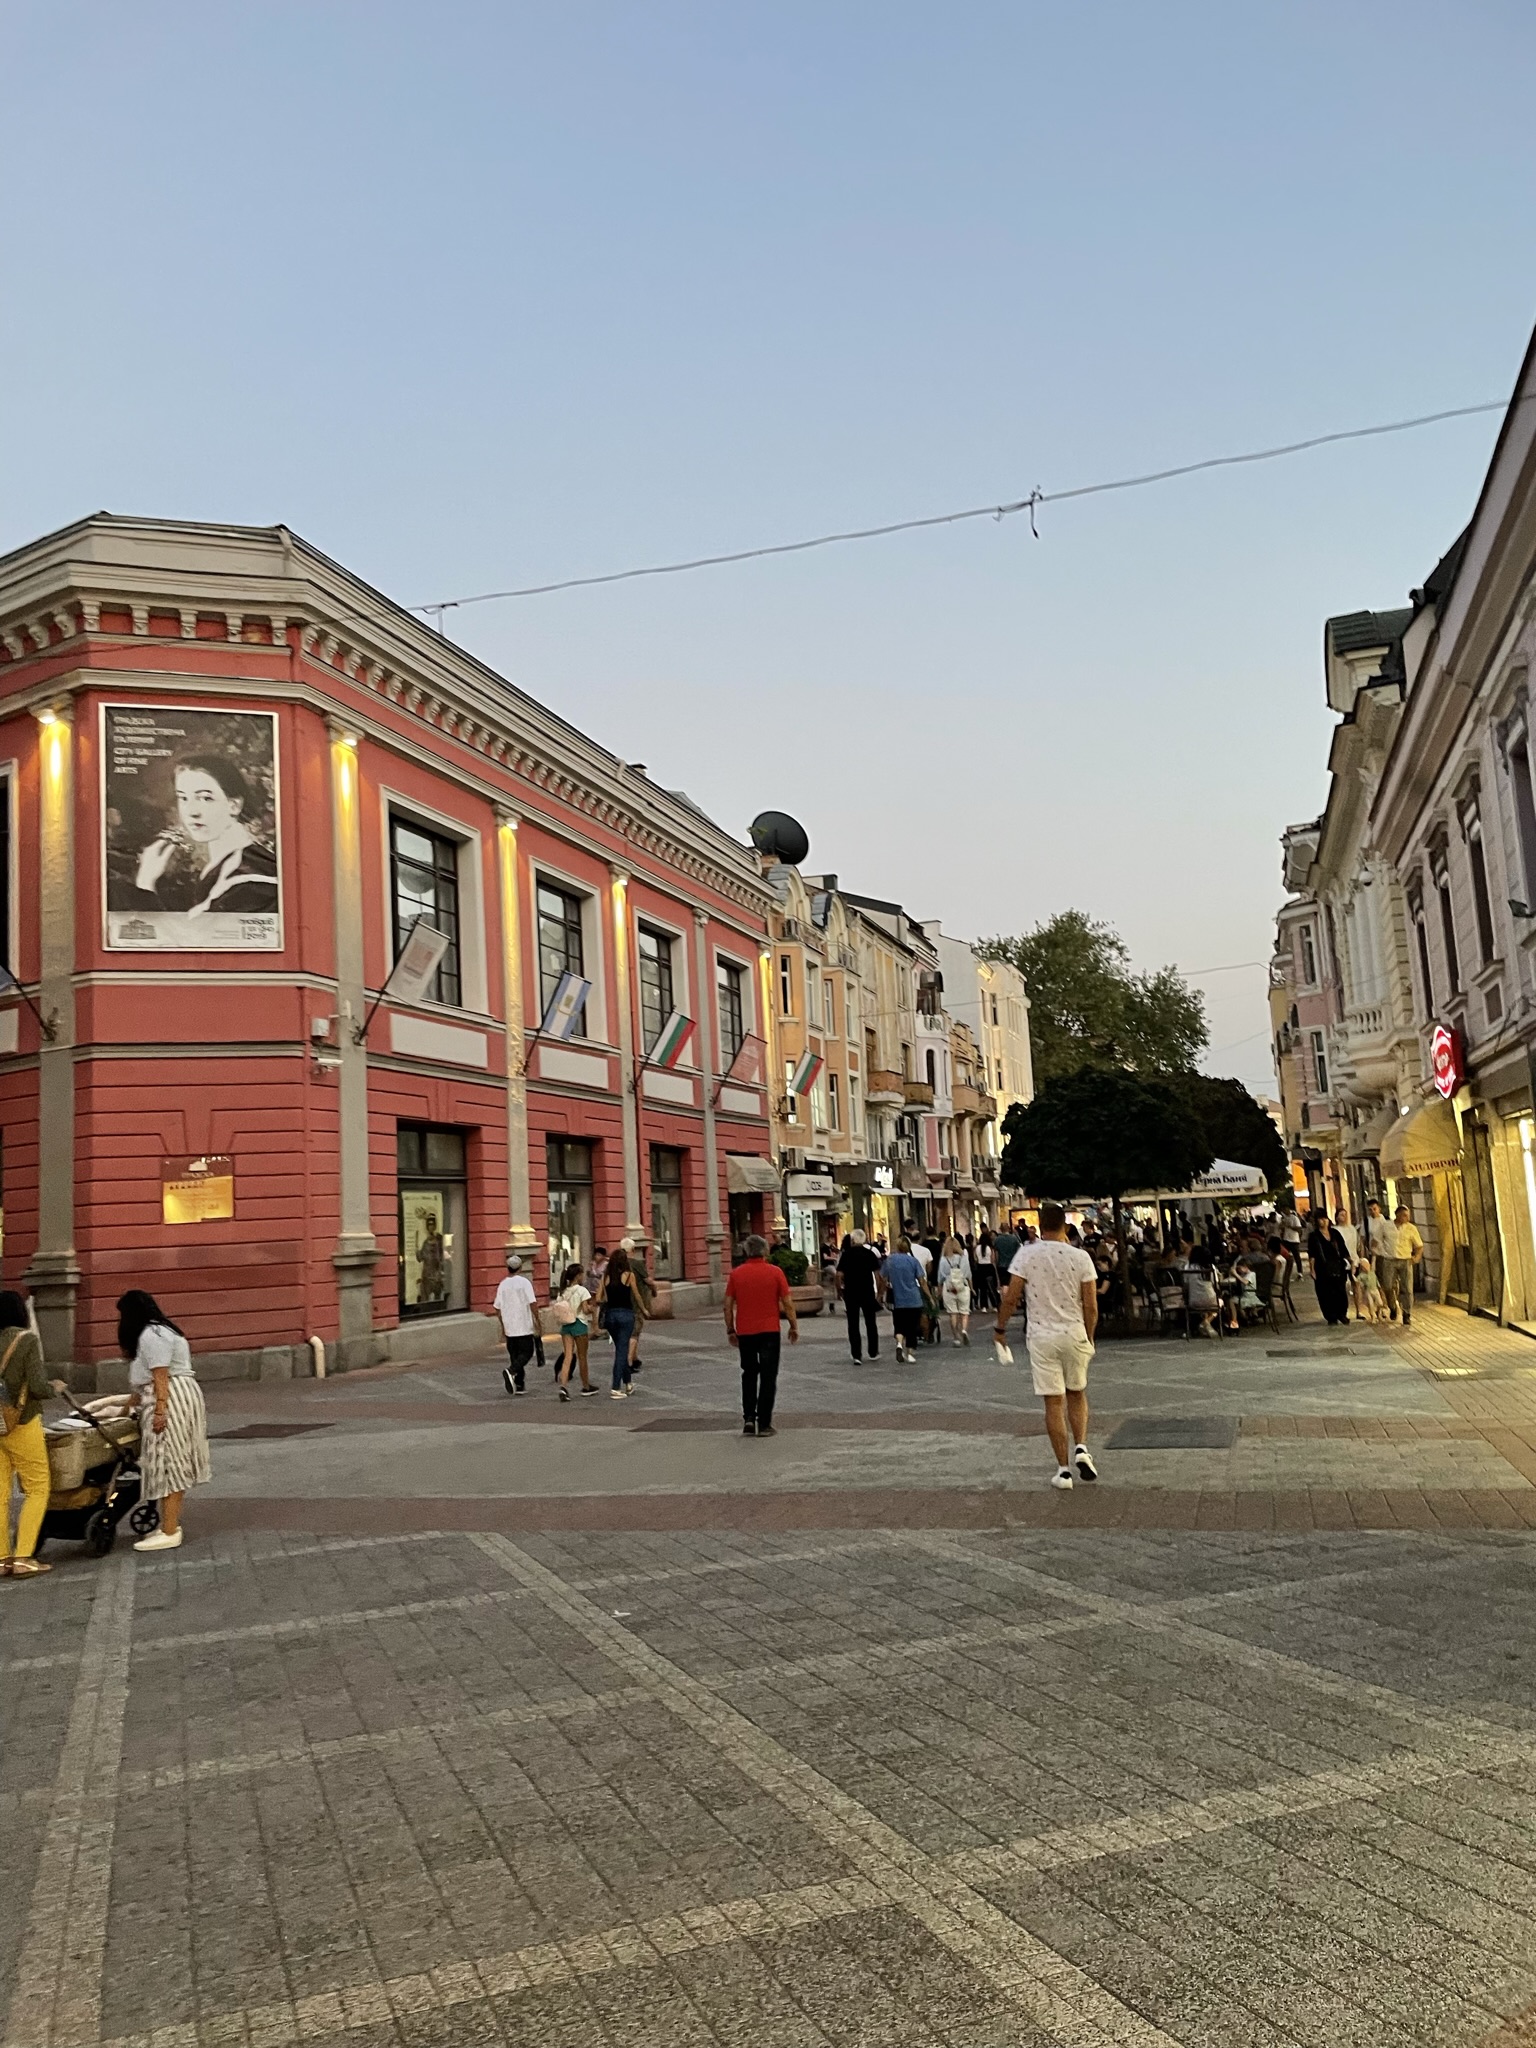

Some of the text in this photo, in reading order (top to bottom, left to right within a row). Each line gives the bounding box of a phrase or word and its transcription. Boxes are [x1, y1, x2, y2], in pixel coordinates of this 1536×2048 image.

[113, 747, 174, 757] CITY GALLERY
[113, 756, 149, 766] OF FINE
[113, 766, 139, 775] ARTS
